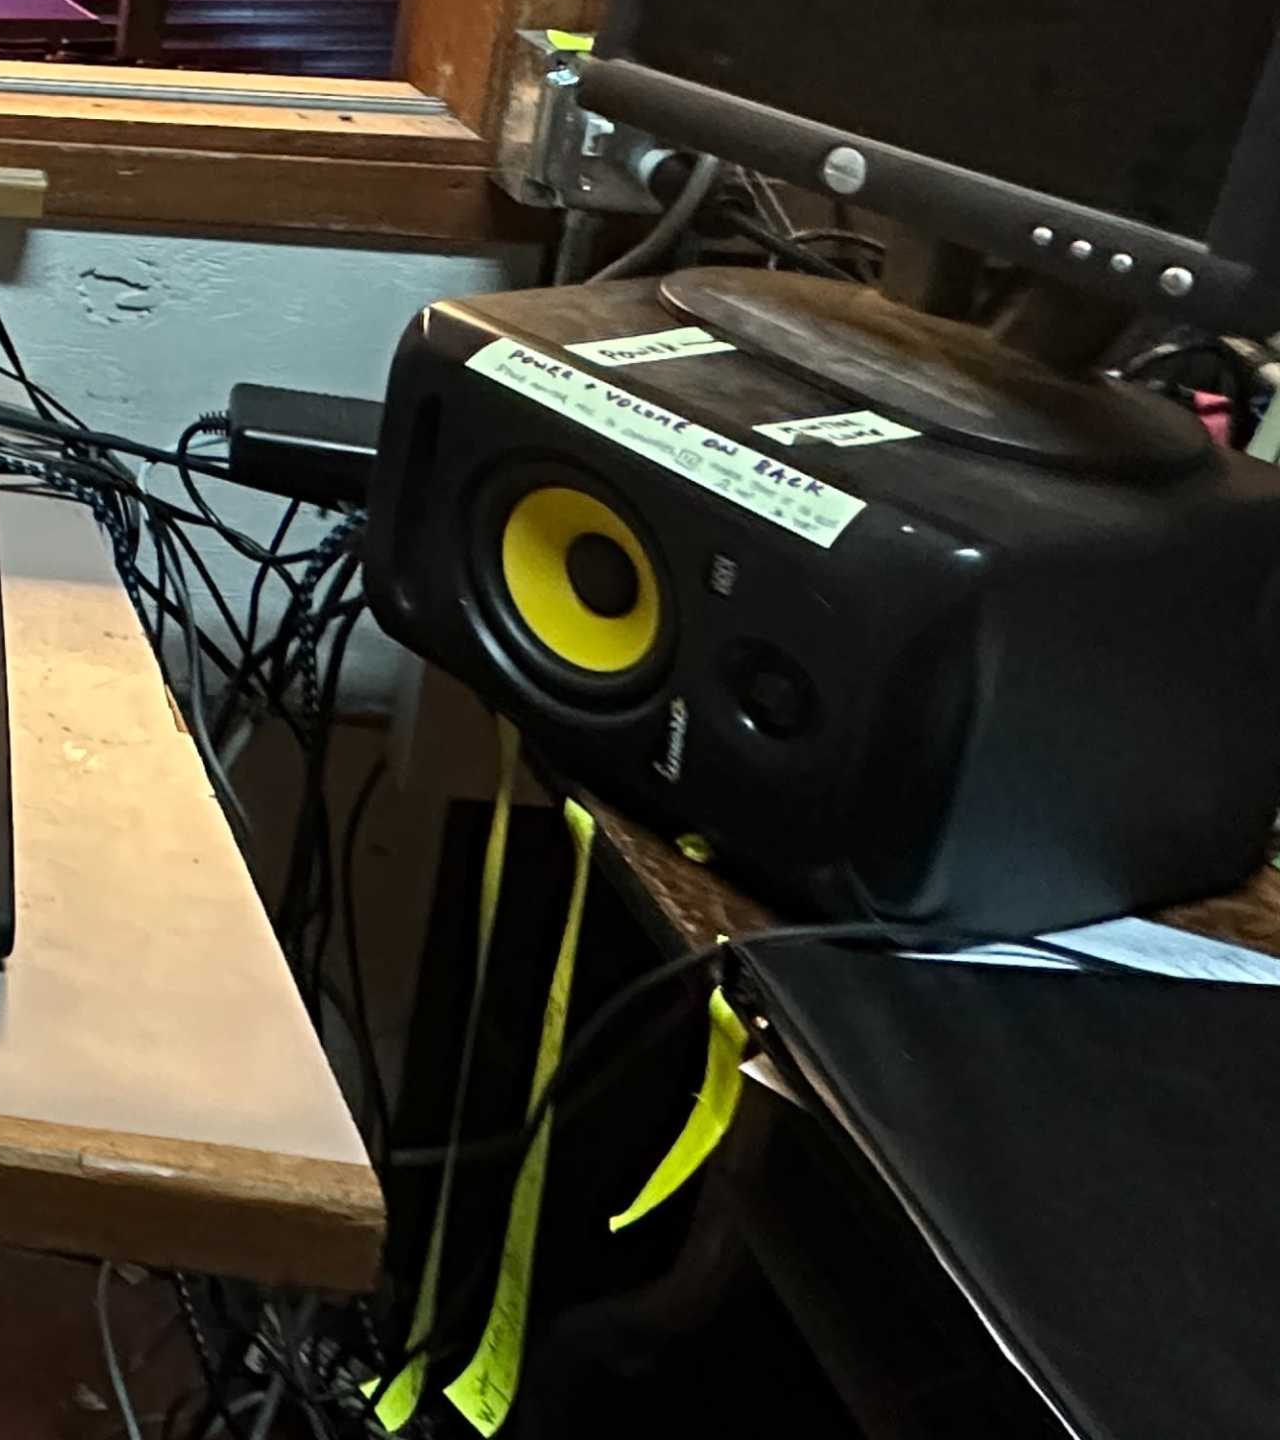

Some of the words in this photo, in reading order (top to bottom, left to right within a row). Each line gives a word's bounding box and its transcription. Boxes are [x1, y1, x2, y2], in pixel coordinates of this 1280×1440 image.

[508, 349, 573, 380] POWER
[702, 438, 739, 456] ON
[753, 459, 824, 497] BACK
